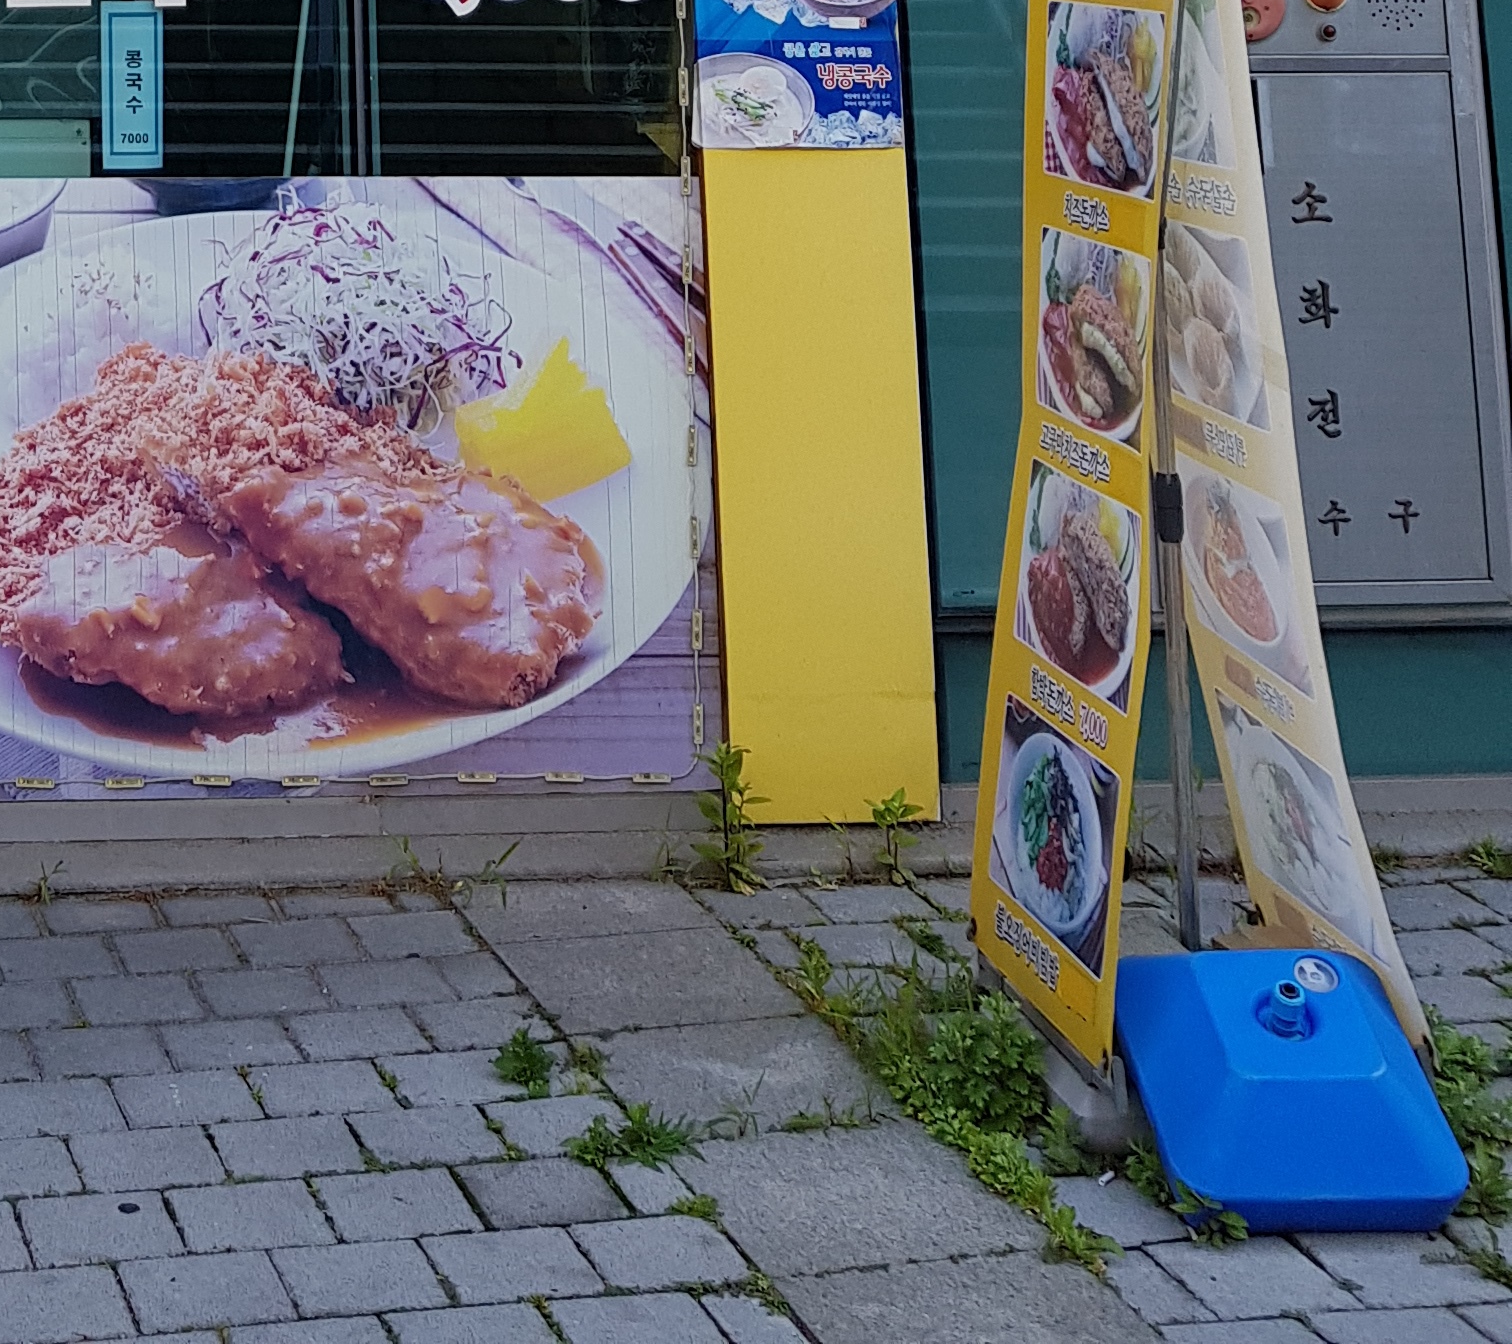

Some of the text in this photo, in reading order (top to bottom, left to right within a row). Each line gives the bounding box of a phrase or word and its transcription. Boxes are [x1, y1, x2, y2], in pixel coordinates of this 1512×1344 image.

[125, 50, 143, 114] 콩국수
[816, 63, 892, 90] 냉콩국수
[121, 133, 149, 144] 7000
[1064, 192, 1109, 231] 치즈돈까스
[1040, 421, 1110, 483] 고구마치즈돈까스
